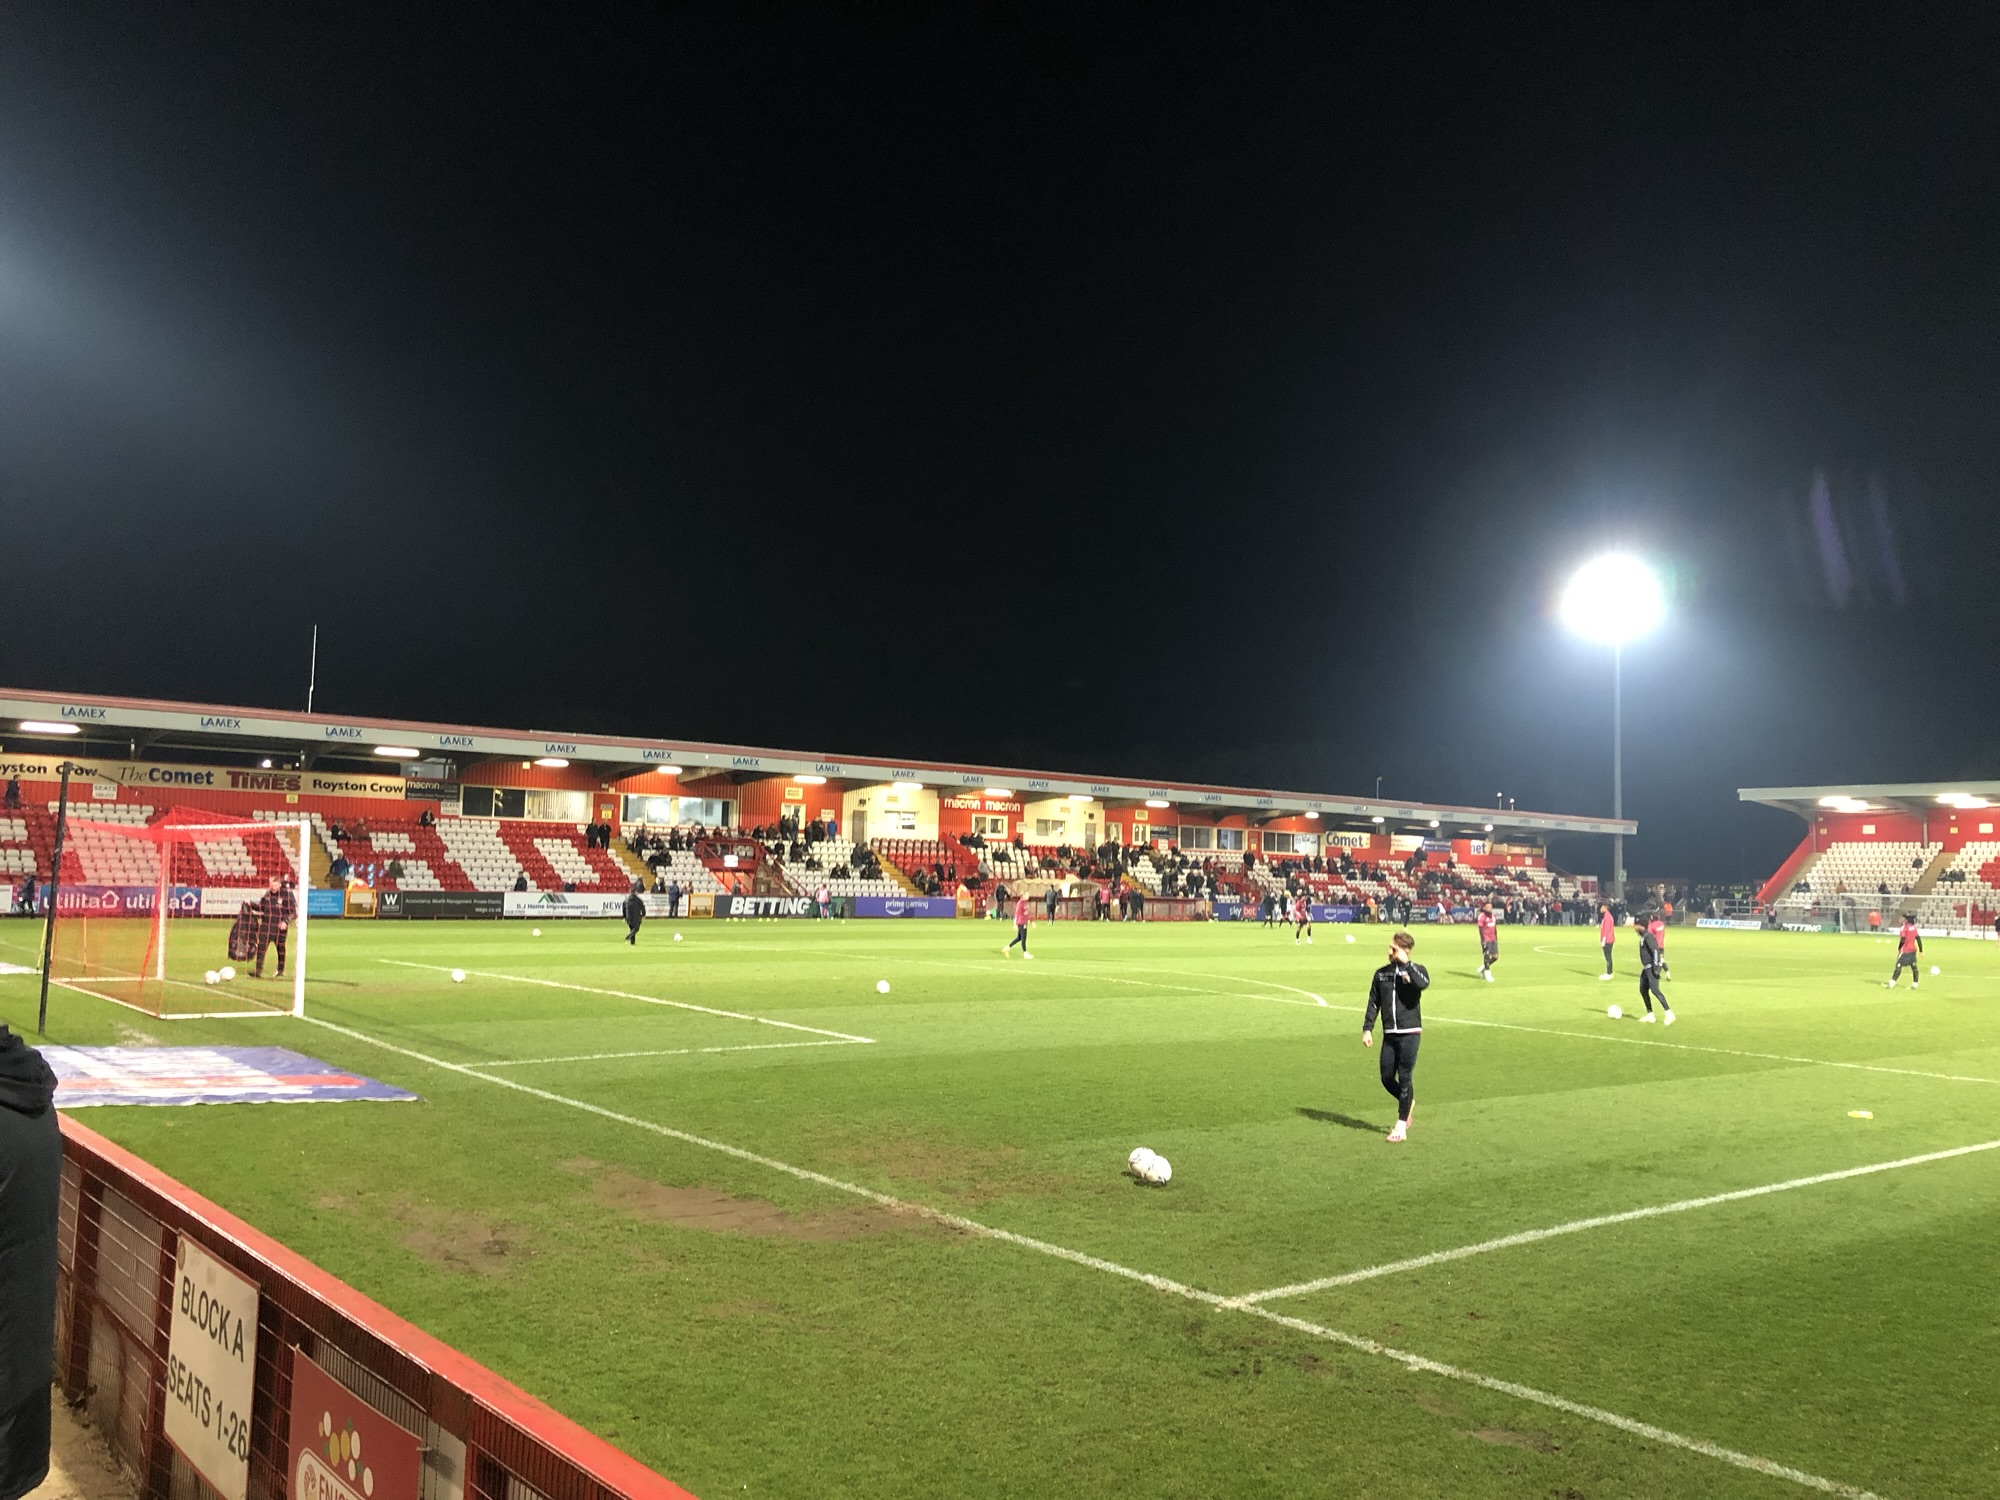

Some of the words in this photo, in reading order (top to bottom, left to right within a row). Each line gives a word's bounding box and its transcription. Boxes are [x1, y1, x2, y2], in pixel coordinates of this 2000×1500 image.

[61, 706, 106, 719] LAMEX
[200, 717, 241, 729] LAMEX
[325, 727, 363, 738] LAMEX
[439, 735, 474, 746] LAMEX
[545, 744, 577, 754] LAMEX
[642, 750, 672, 760] LAMEX
[732, 757, 760, 767] LAMEX
[0, 762, 47, 775] yston
[815, 764, 840, 773] LAMEX
[118, 766, 147, 782] The
[149, 767, 214, 785] Comet
[892, 770, 915, 779] LAMEX
[962, 775, 984, 784] LAMEX
[312, 779, 367, 792] Royston
[370, 785, 403, 793] Crow
[406, 781, 440, 790] macron
[945, 798, 980, 810] macron
[986, 800, 1021, 812] macron
[1326, 832, 1364, 847] Comet
[384, 893, 398, 905] W
[885, 899, 904, 908] prime
[905, 900, 929, 909] gaming
[546, 903, 589, 911] Improvements
[729, 897, 811, 914] BETTING
[1229, 906, 1241, 917] sky
[1243, 906, 1256, 914] bet
[181, 1276, 231, 1350] BLOCK
[232, 1318, 244, 1363] A
[168, 1354, 212, 1428] SEATS
[216, 1400, 248, 1462] 1-26
